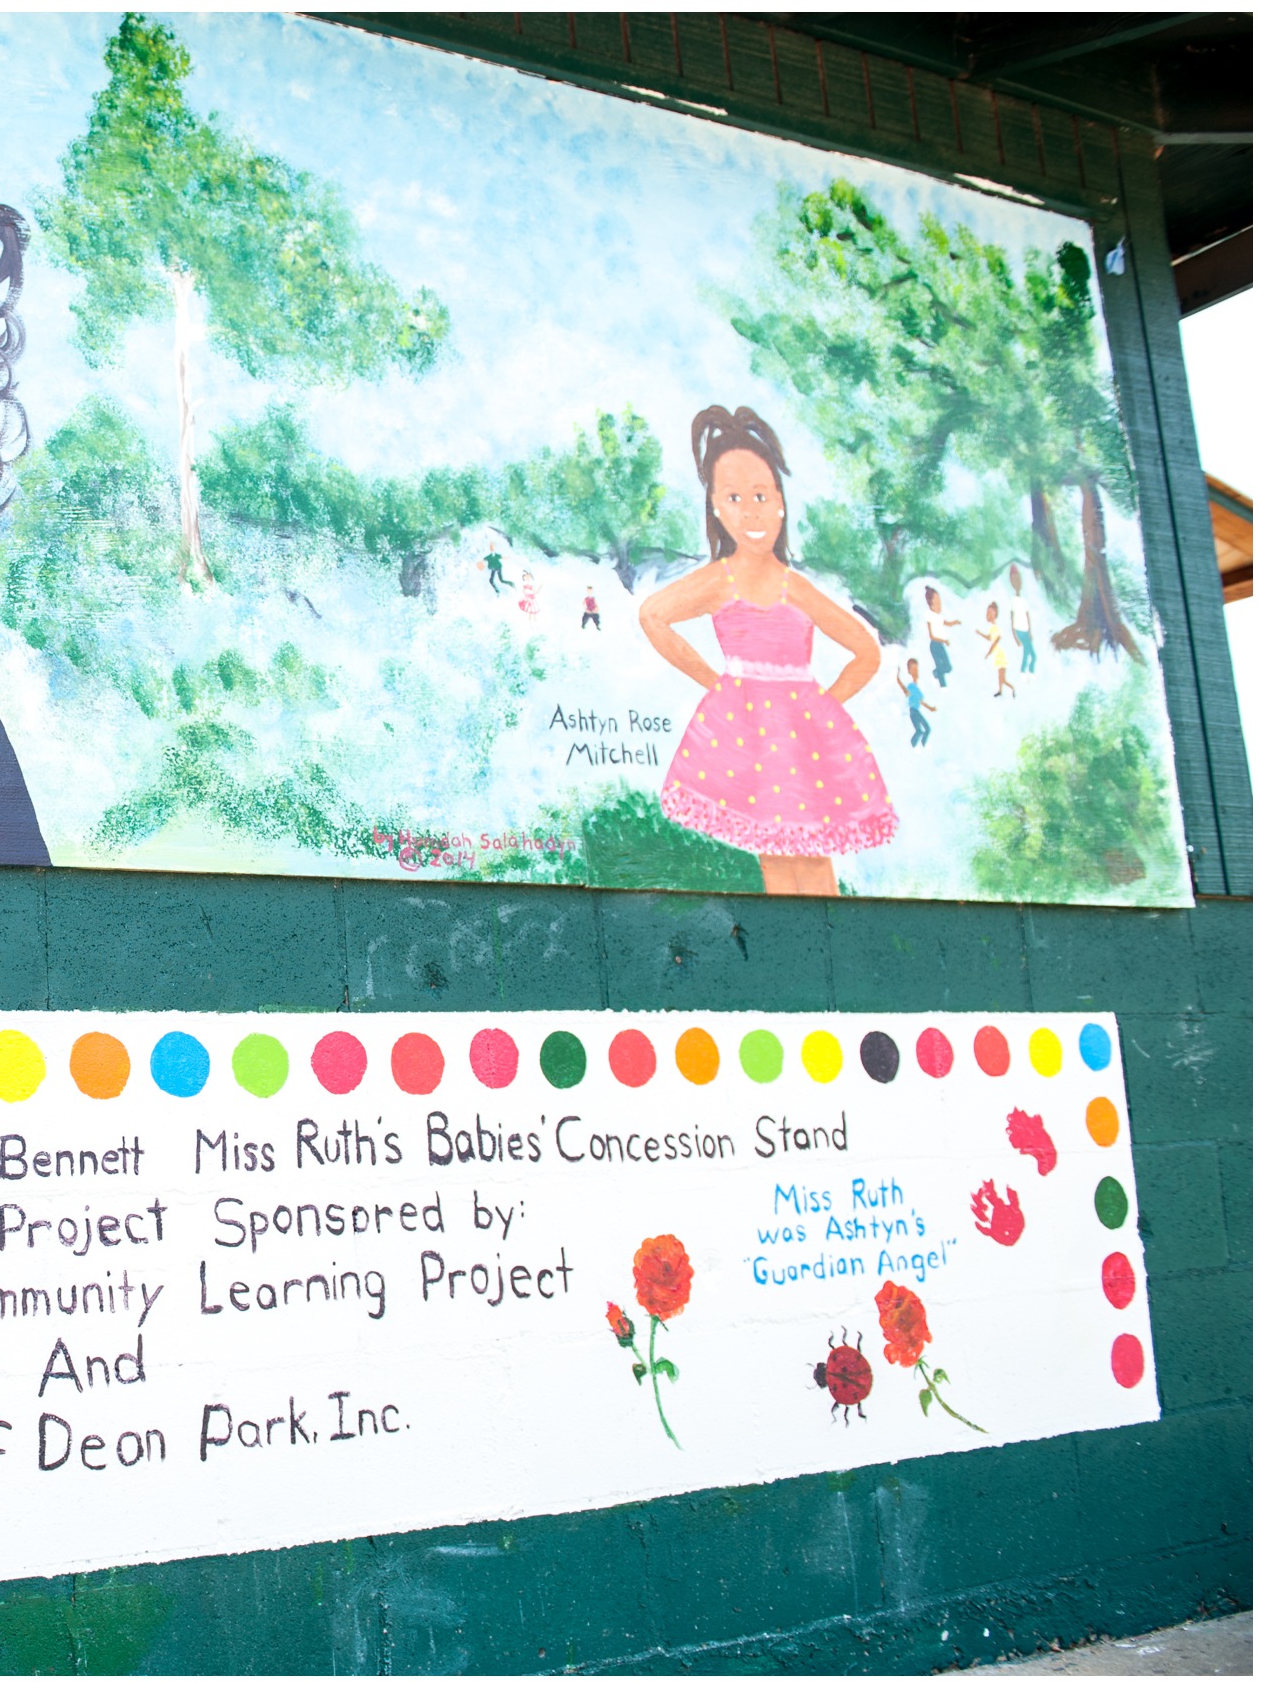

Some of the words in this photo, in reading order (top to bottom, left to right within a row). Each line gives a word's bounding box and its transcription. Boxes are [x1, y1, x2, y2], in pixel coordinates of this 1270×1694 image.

[548, 703, 619, 736] Ashtyn
[629, 709, 672, 733] Rose
[565, 740, 660, 766] Mitchell
[429, 848, 476, 869] 2014
[196, 1129, 274, 1174] Miss
[297, 1117, 402, 1168] Ruth's
[427, 1111, 545, 1166] Babies'
[556, 1116, 734, 1162] Concession
[755, 1112, 847, 1158] Stand
[775, 1184, 831, 1215] Miss
[852, 1178, 903, 1210] Ruth
[215, 1192, 444, 1256] Sponsored
[474, 1191, 524, 1240] by:
[758, 1225, 806, 1244] was
[824, 1206, 925, 1243] Ashtyn's
[200, 1261, 385, 1319] Learning
[421, 1247, 573, 1306] Project
[744, 1253, 865, 1285] "Guardian
[874, 1236, 956, 1283] Angel"
[38, 1334, 145, 1397] And
[329, 1392, 409, 1441] Inc.
